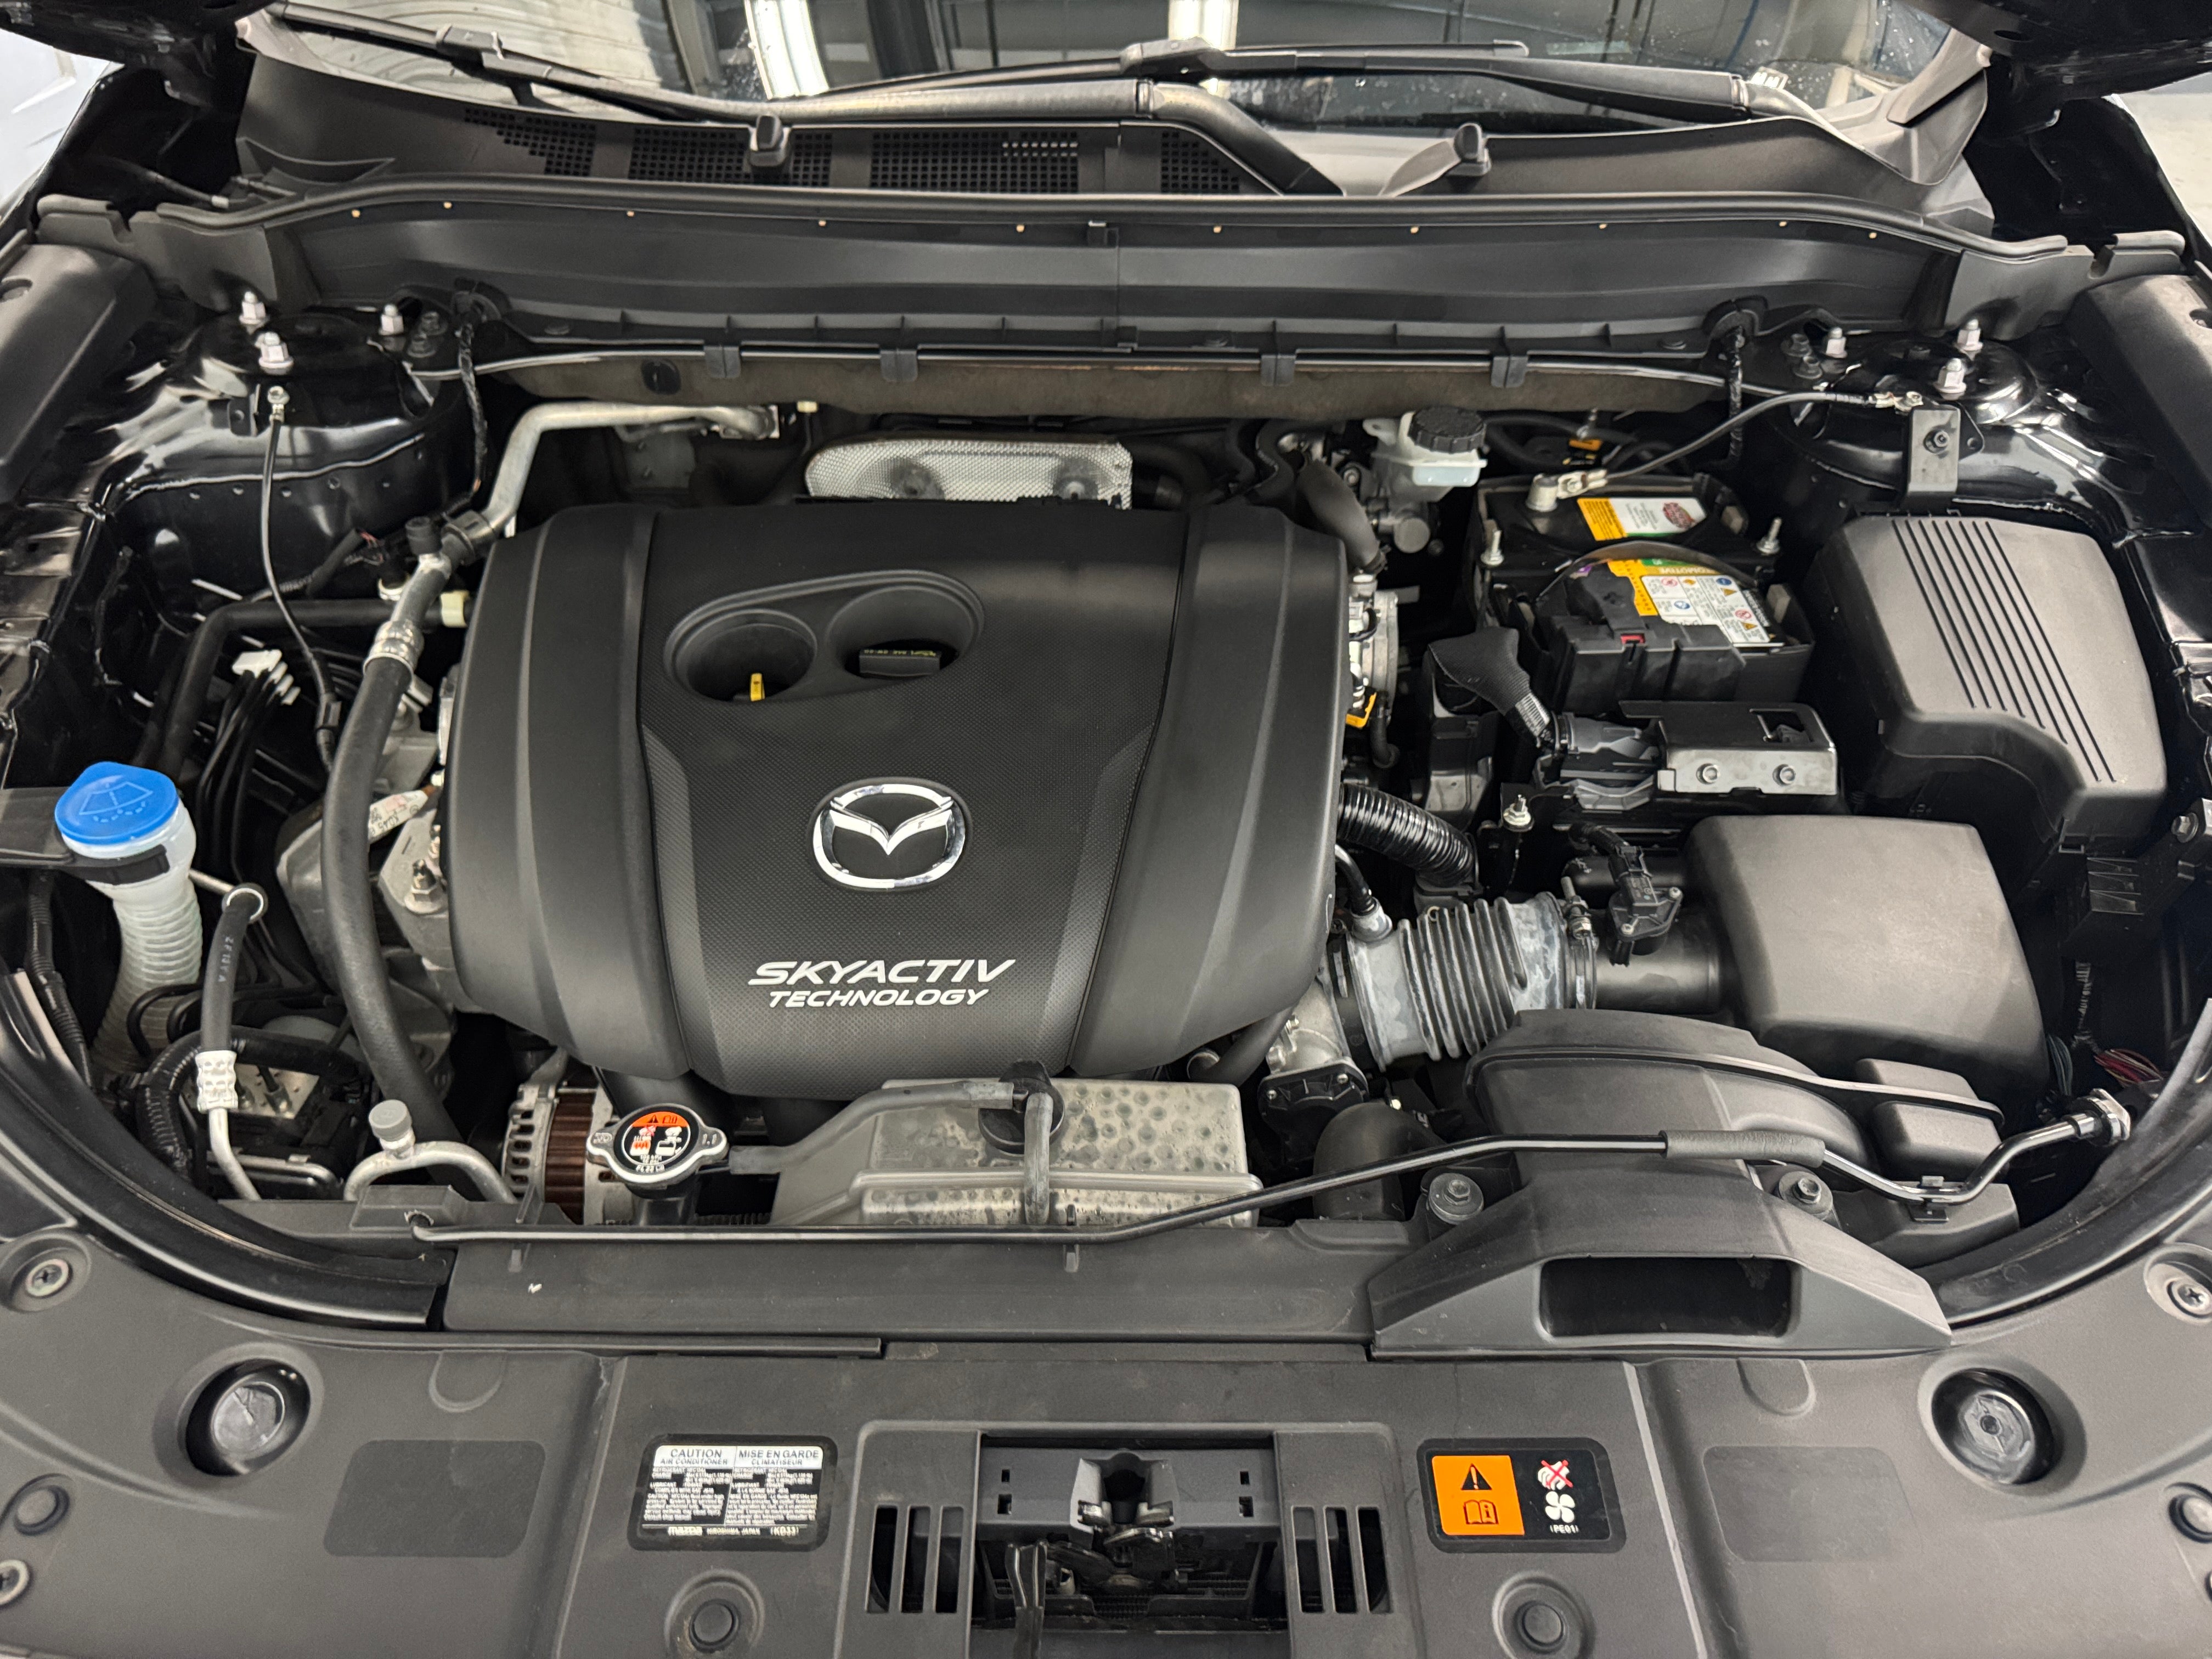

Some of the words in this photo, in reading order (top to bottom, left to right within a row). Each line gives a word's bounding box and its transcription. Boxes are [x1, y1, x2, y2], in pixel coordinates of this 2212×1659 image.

[748, 959, 1017, 985] SKYACTIV
[769, 989, 990, 1008] TECHNOLOGY
[670, 1448, 723, 1458] CAUTION
[738, 1449, 764, 1458] MISE
[766, 1450, 781, 1458] EN
[782, 1450, 819, 1458] GARDE
[668, 1526, 703, 1536] mazda
[741, 1527, 761, 1536] JAPAN
